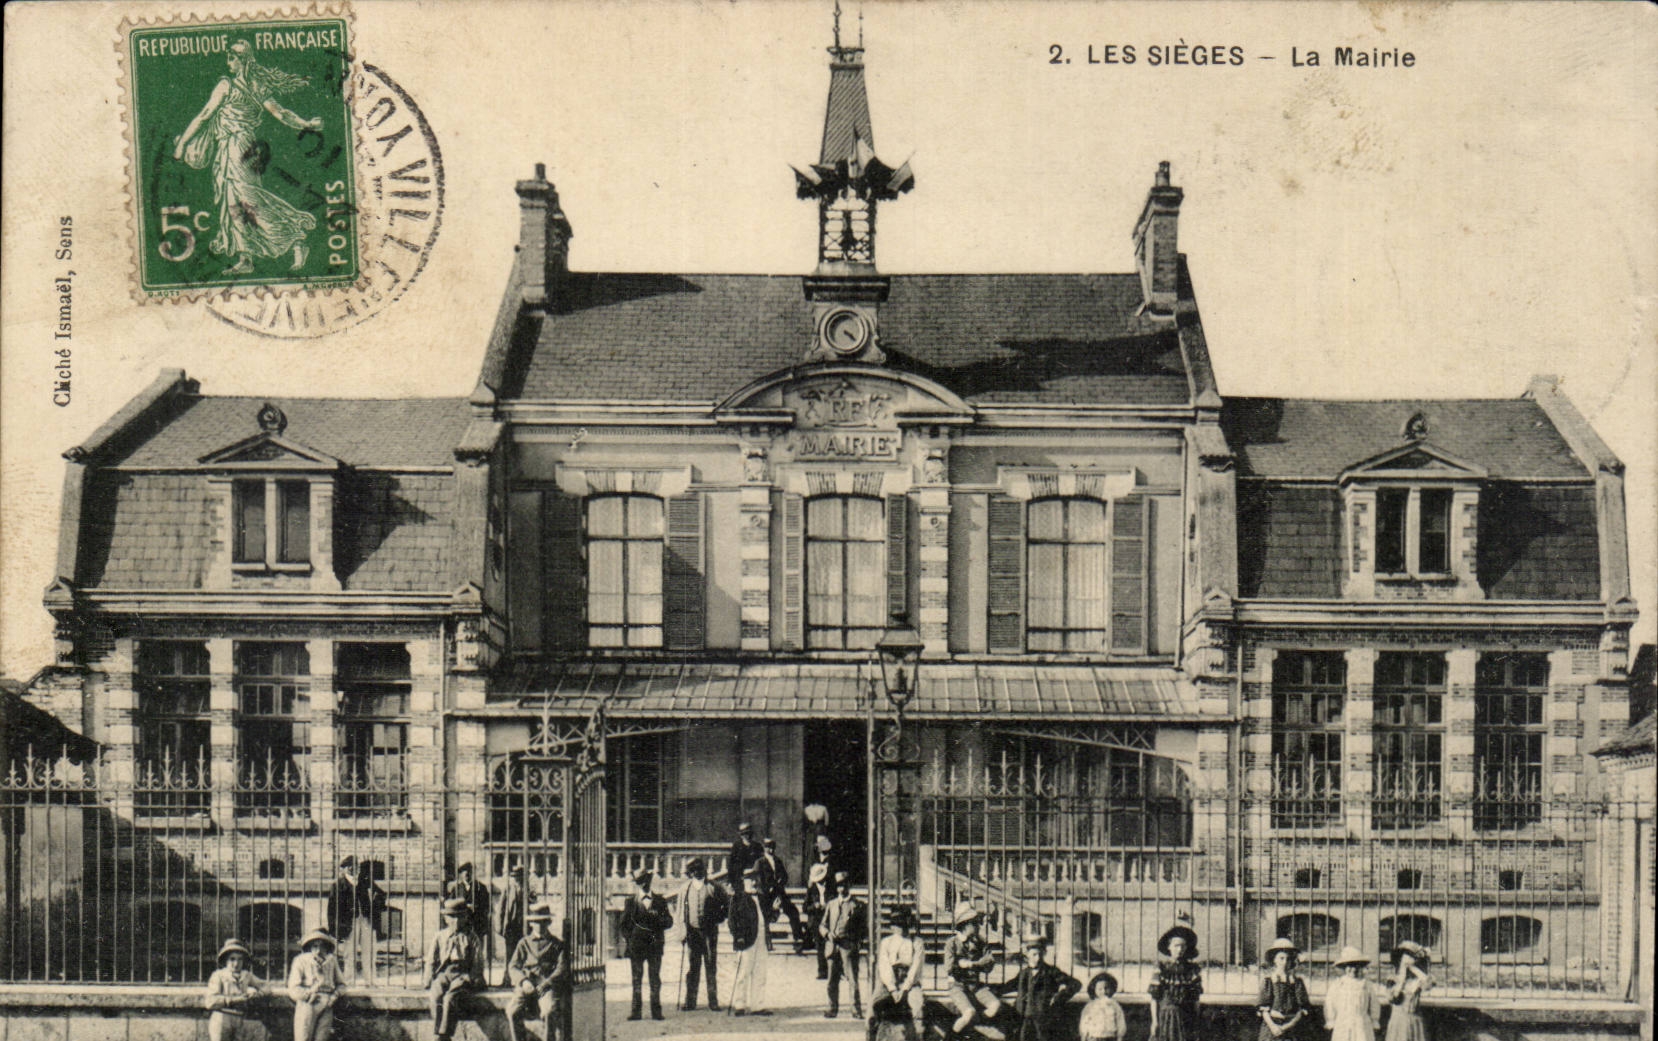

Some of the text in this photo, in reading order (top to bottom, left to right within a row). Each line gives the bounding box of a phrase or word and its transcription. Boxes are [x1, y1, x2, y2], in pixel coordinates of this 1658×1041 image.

[255, 29, 338, 51] FRANÇAISE
[324, 180, 349, 265] POSTES
[800, 434, 892, 456] MAIRIE
